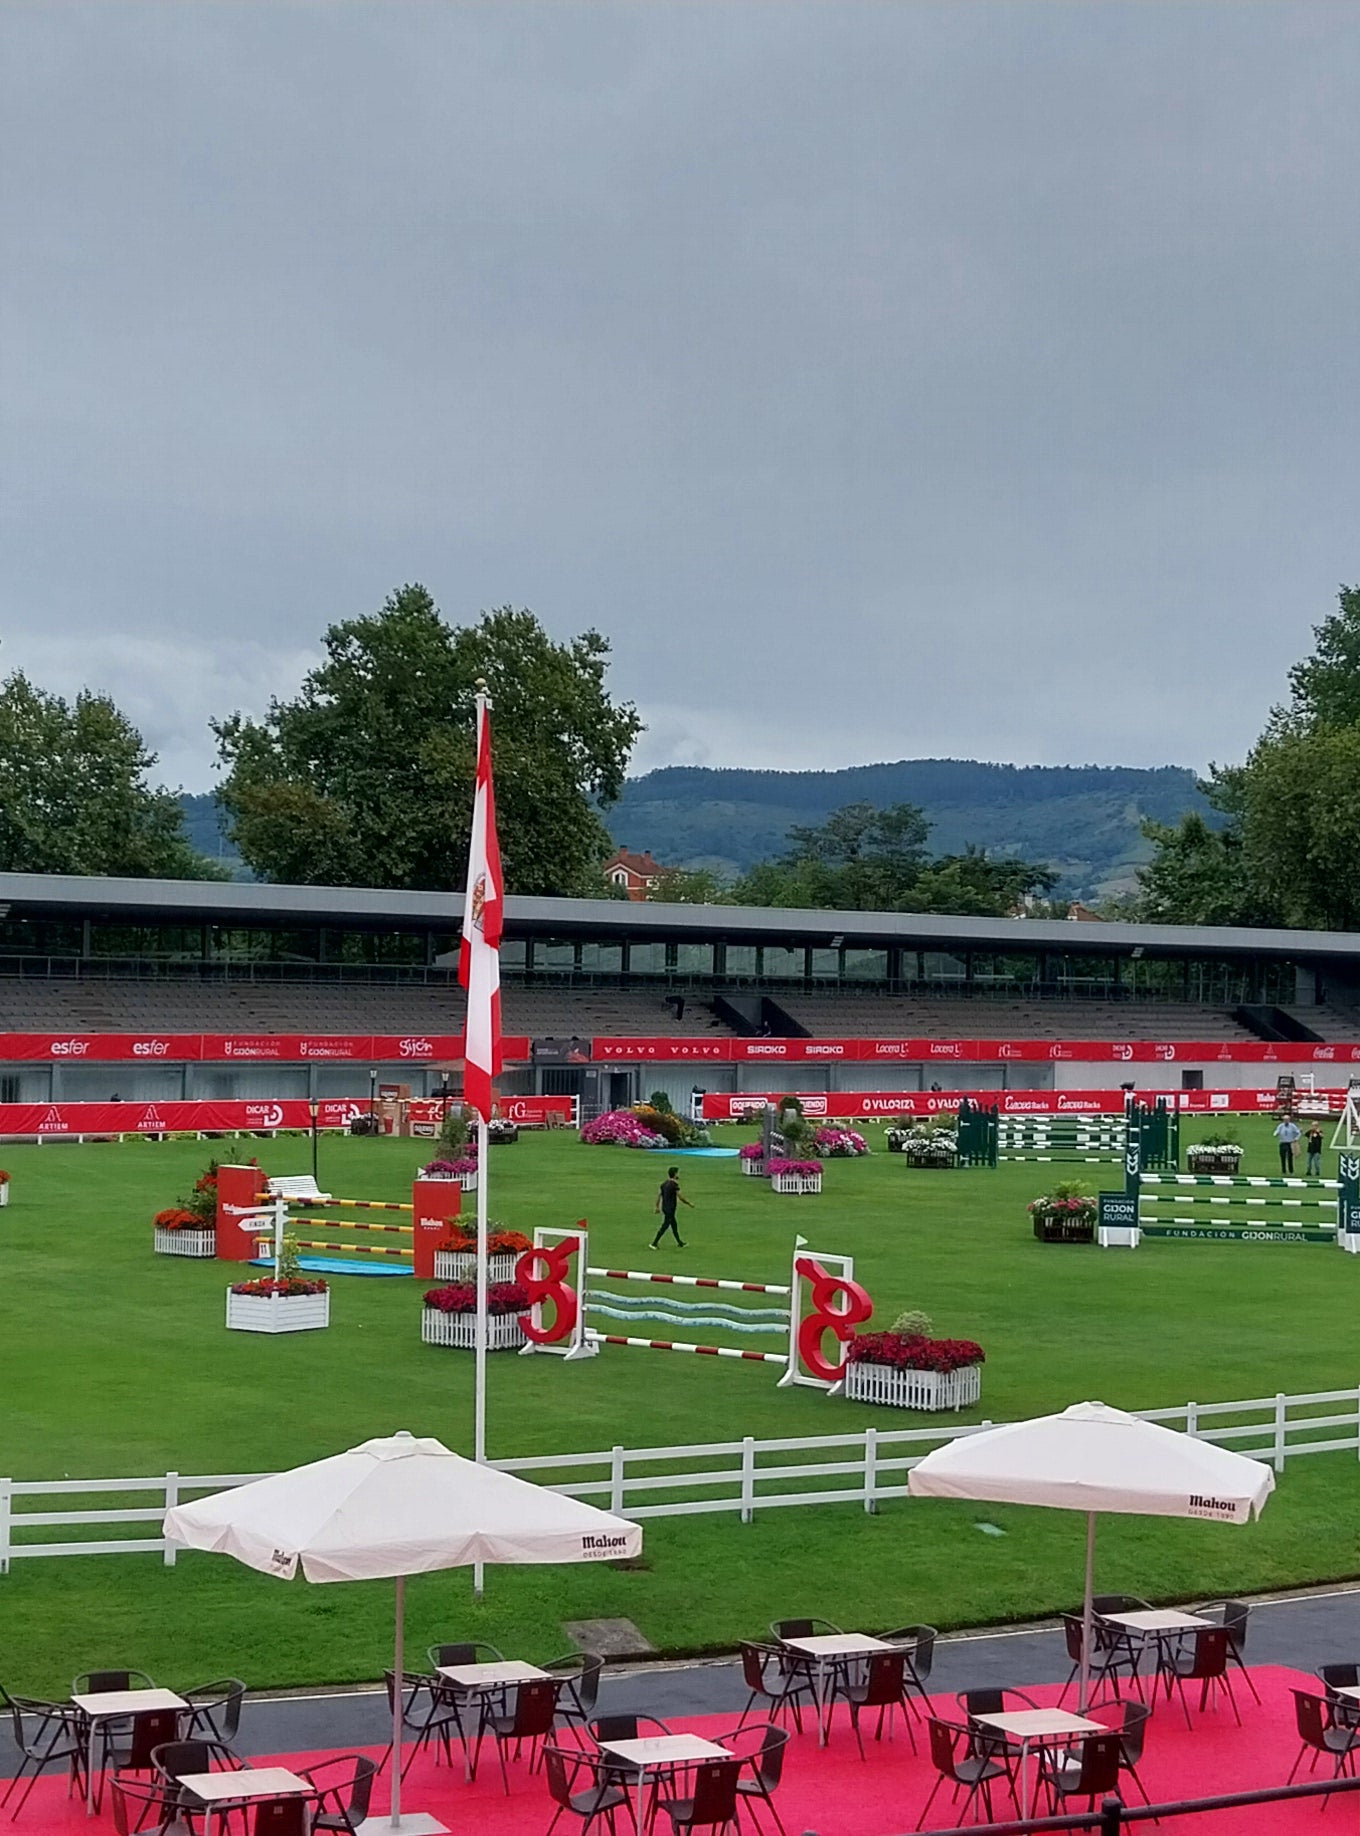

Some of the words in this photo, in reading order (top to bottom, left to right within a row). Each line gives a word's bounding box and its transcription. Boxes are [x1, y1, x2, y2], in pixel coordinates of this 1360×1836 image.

[51, 1038, 90, 1055] esfer
[133, 1038, 170, 1055] esfer
[747, 1045, 787, 1054] SIROKO
[805, 1045, 844, 1054] SIROKO
[325, 1104, 347, 1113] DICAR
[872, 1099, 915, 1109] VALORIZA
[246, 1105, 270, 1114] DICAR
[1103, 1213, 1133, 1222] RURAL
[1166, 1229, 1235, 1238] FUNDACIÓN
[1189, 1495, 1236, 1511] Mahou
[582, 1534, 626, 1549] Mahou
